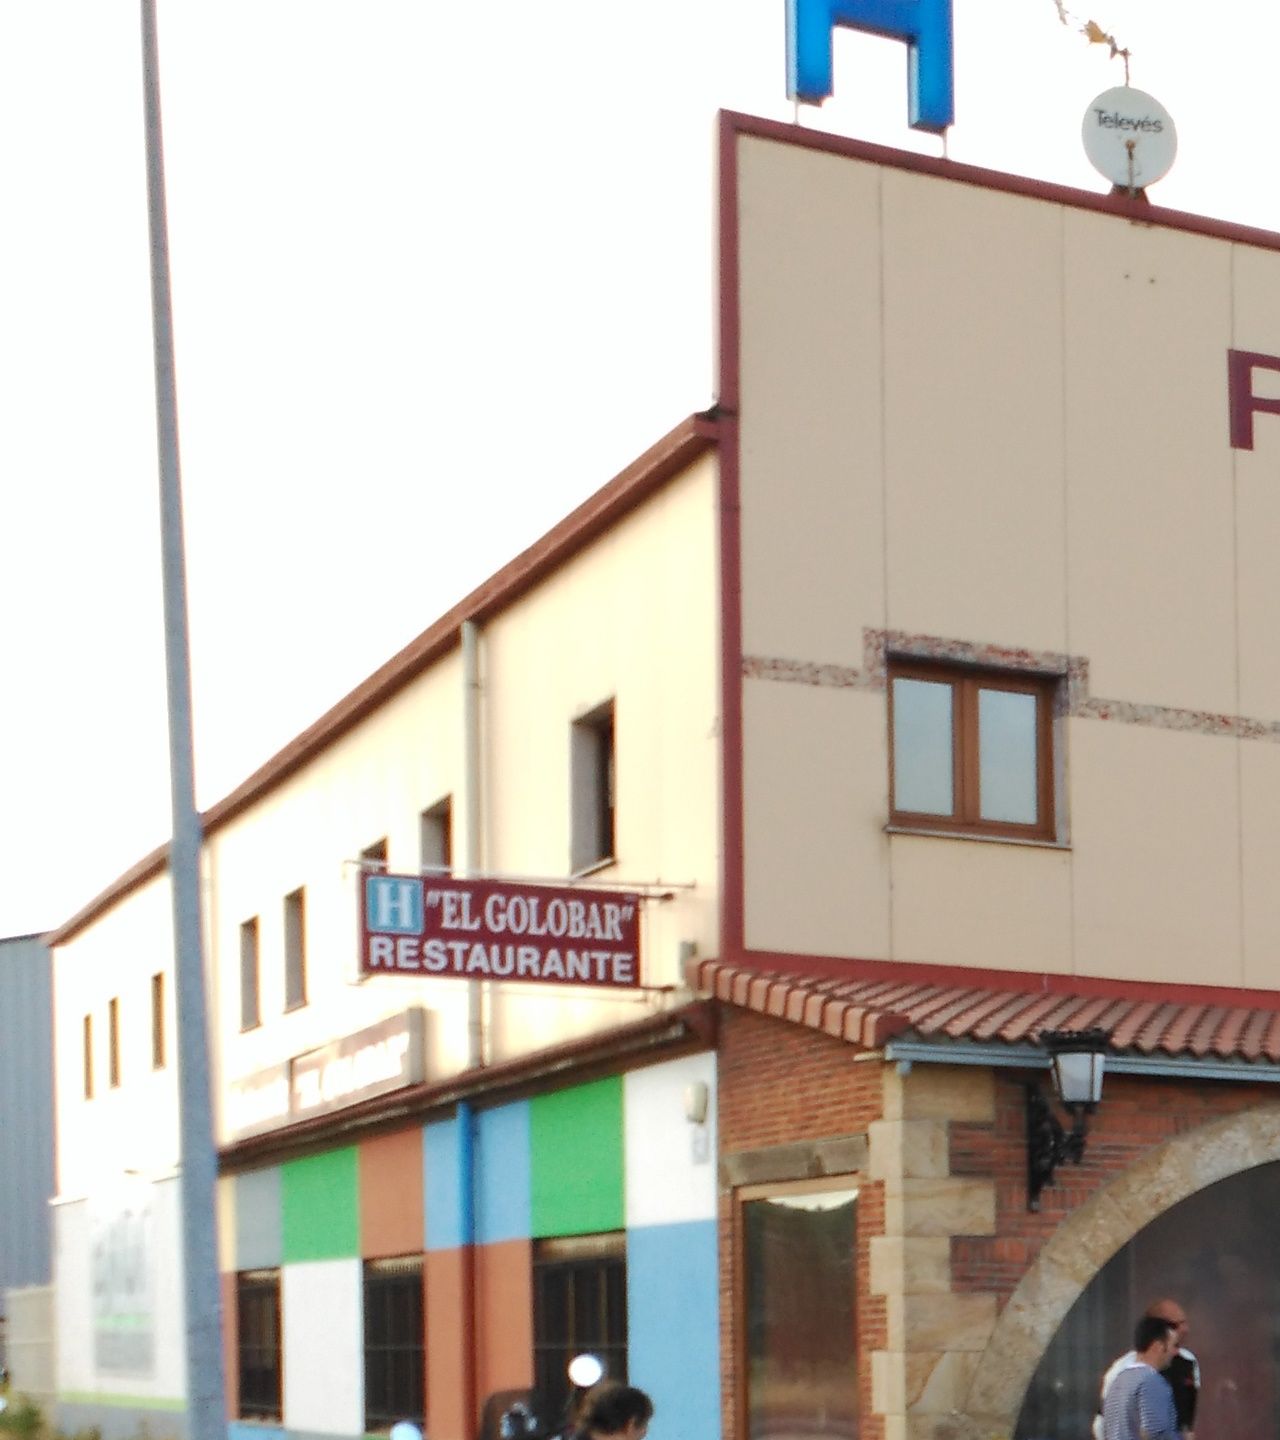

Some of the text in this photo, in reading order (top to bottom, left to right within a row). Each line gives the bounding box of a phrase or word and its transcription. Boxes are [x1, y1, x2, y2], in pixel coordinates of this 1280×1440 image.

[1094, 109, 1164, 134] Televés
[378, 883, 415, 928] H
[369, 935, 635, 982] RESTAURANTE
